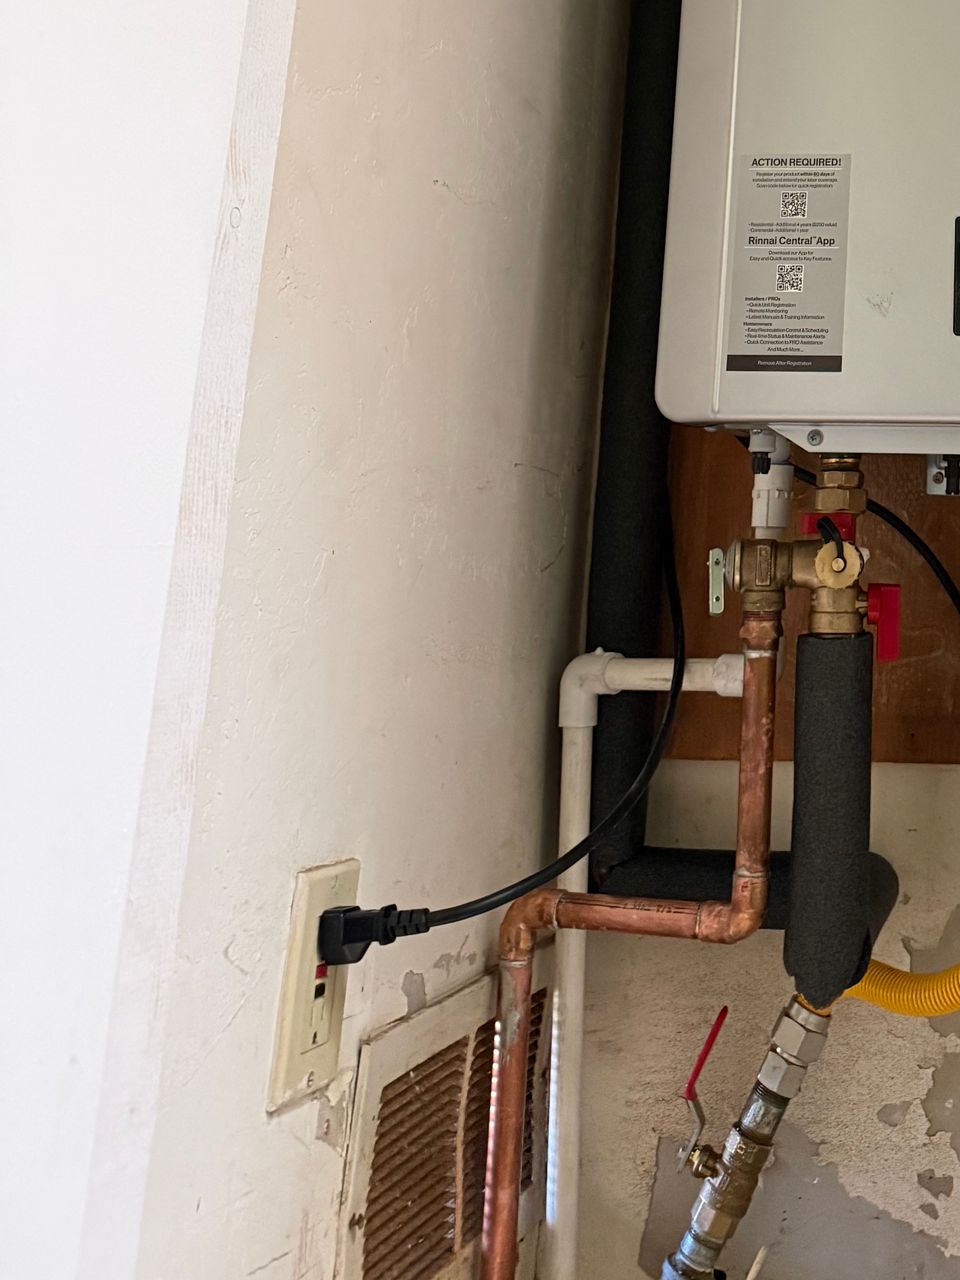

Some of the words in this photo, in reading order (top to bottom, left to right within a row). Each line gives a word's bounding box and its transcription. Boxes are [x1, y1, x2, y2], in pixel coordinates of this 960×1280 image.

[751, 158, 788, 167] ACTION
[789, 158, 842, 167] REQUIRED!
[748, 236, 778, 245] Rinnai
[816, 236, 836, 246] App
